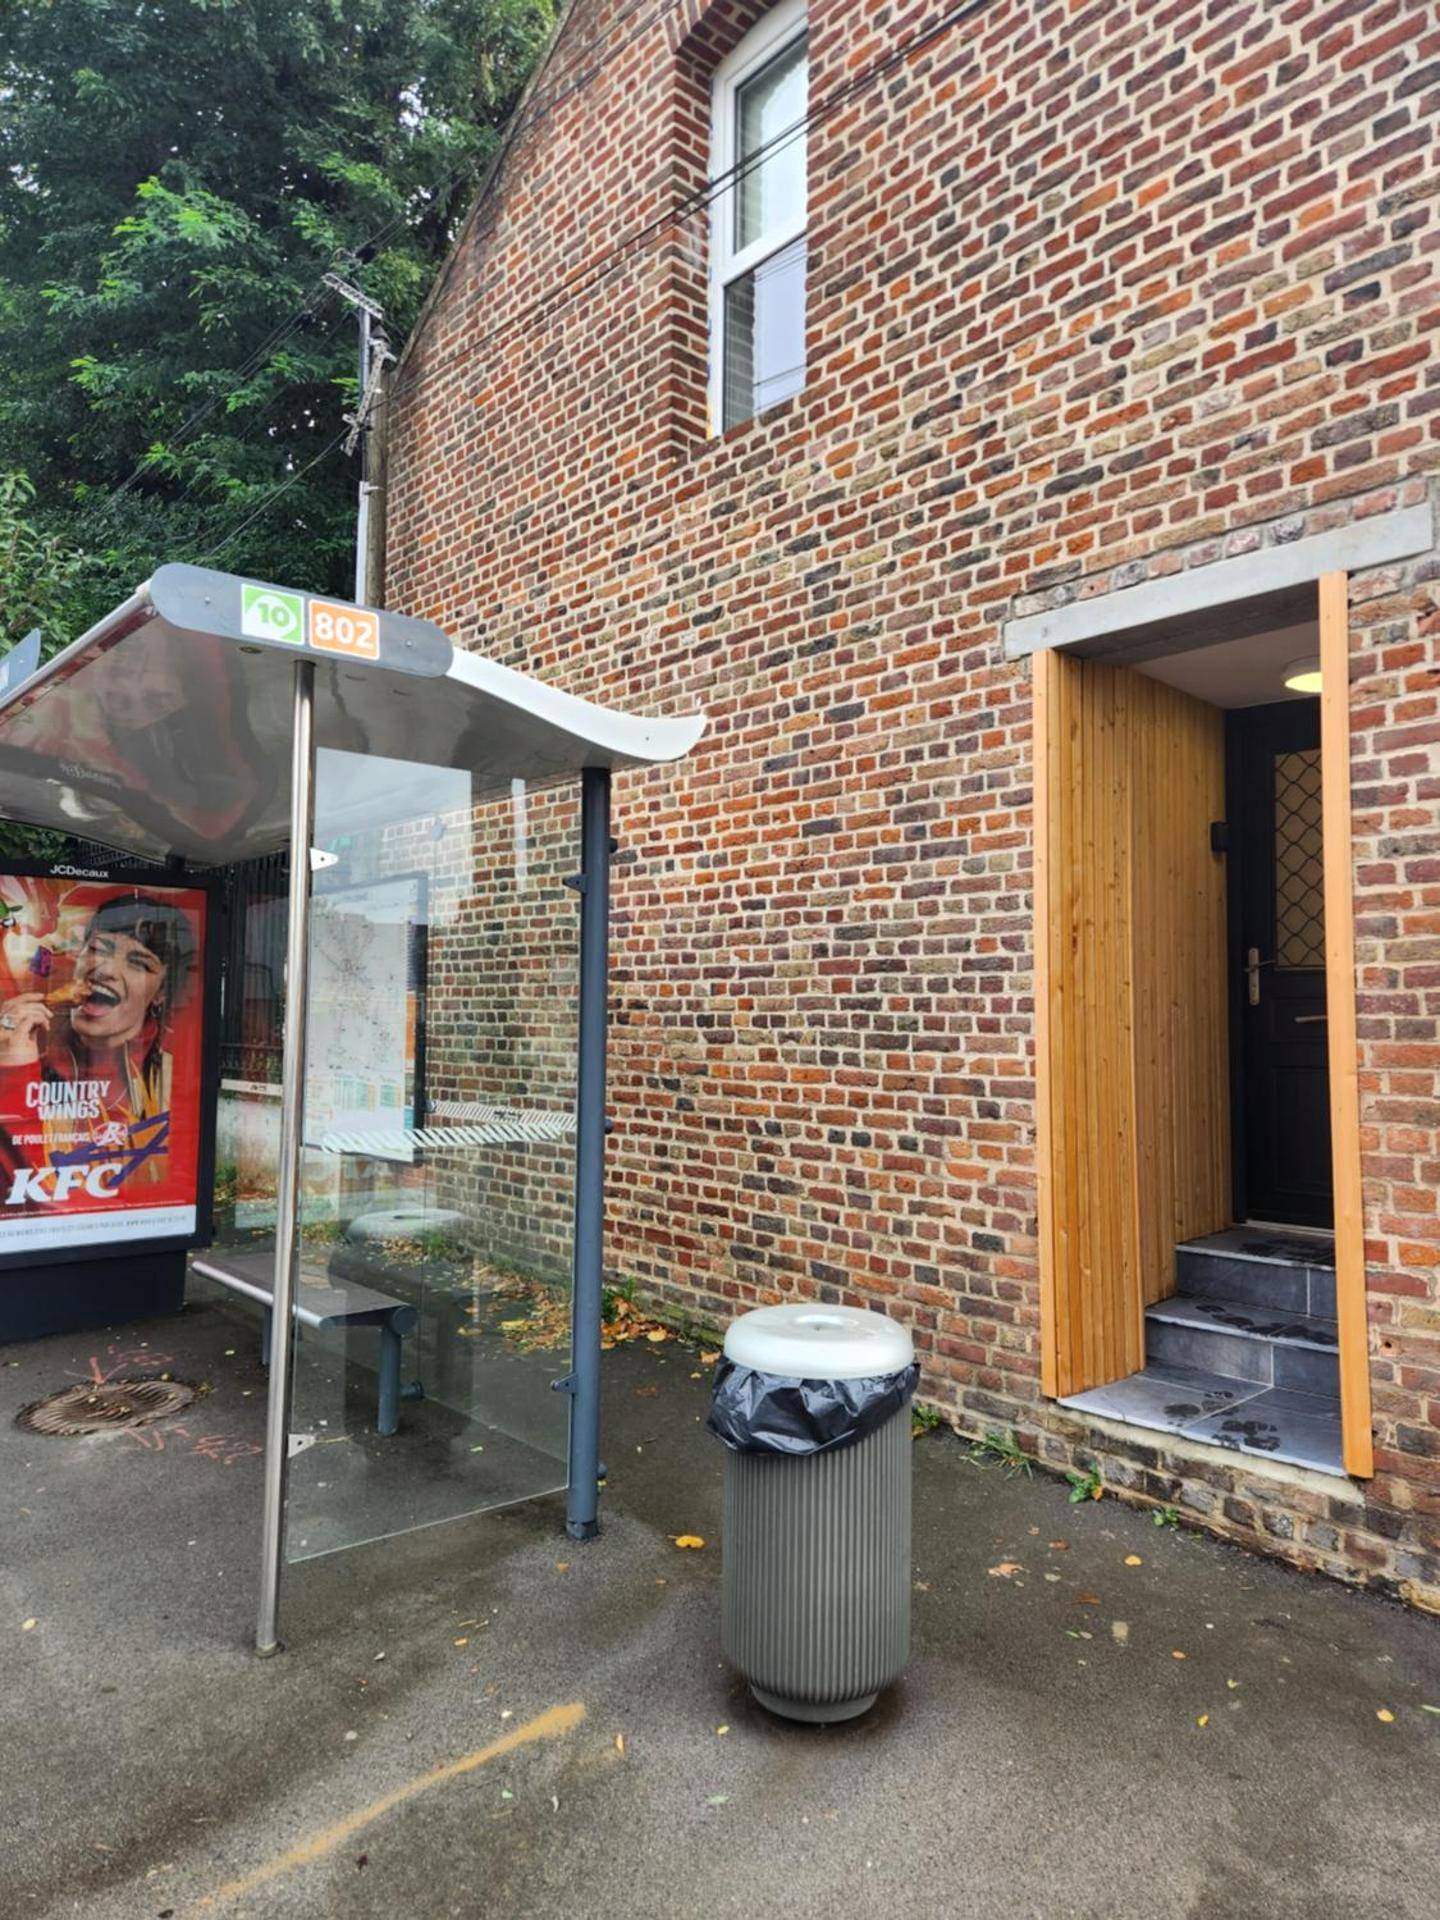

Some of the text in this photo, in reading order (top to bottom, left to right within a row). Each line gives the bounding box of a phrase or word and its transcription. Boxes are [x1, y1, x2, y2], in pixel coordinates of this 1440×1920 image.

[257, 603, 291, 628] 10
[314, 611, 375, 650] 802
[49, 864, 109, 879] JCDecaux
[25, 1080, 111, 1108] COUNTRY
[38, 1099, 101, 1120] WINGS
[5, 1163, 122, 1205] KFC
